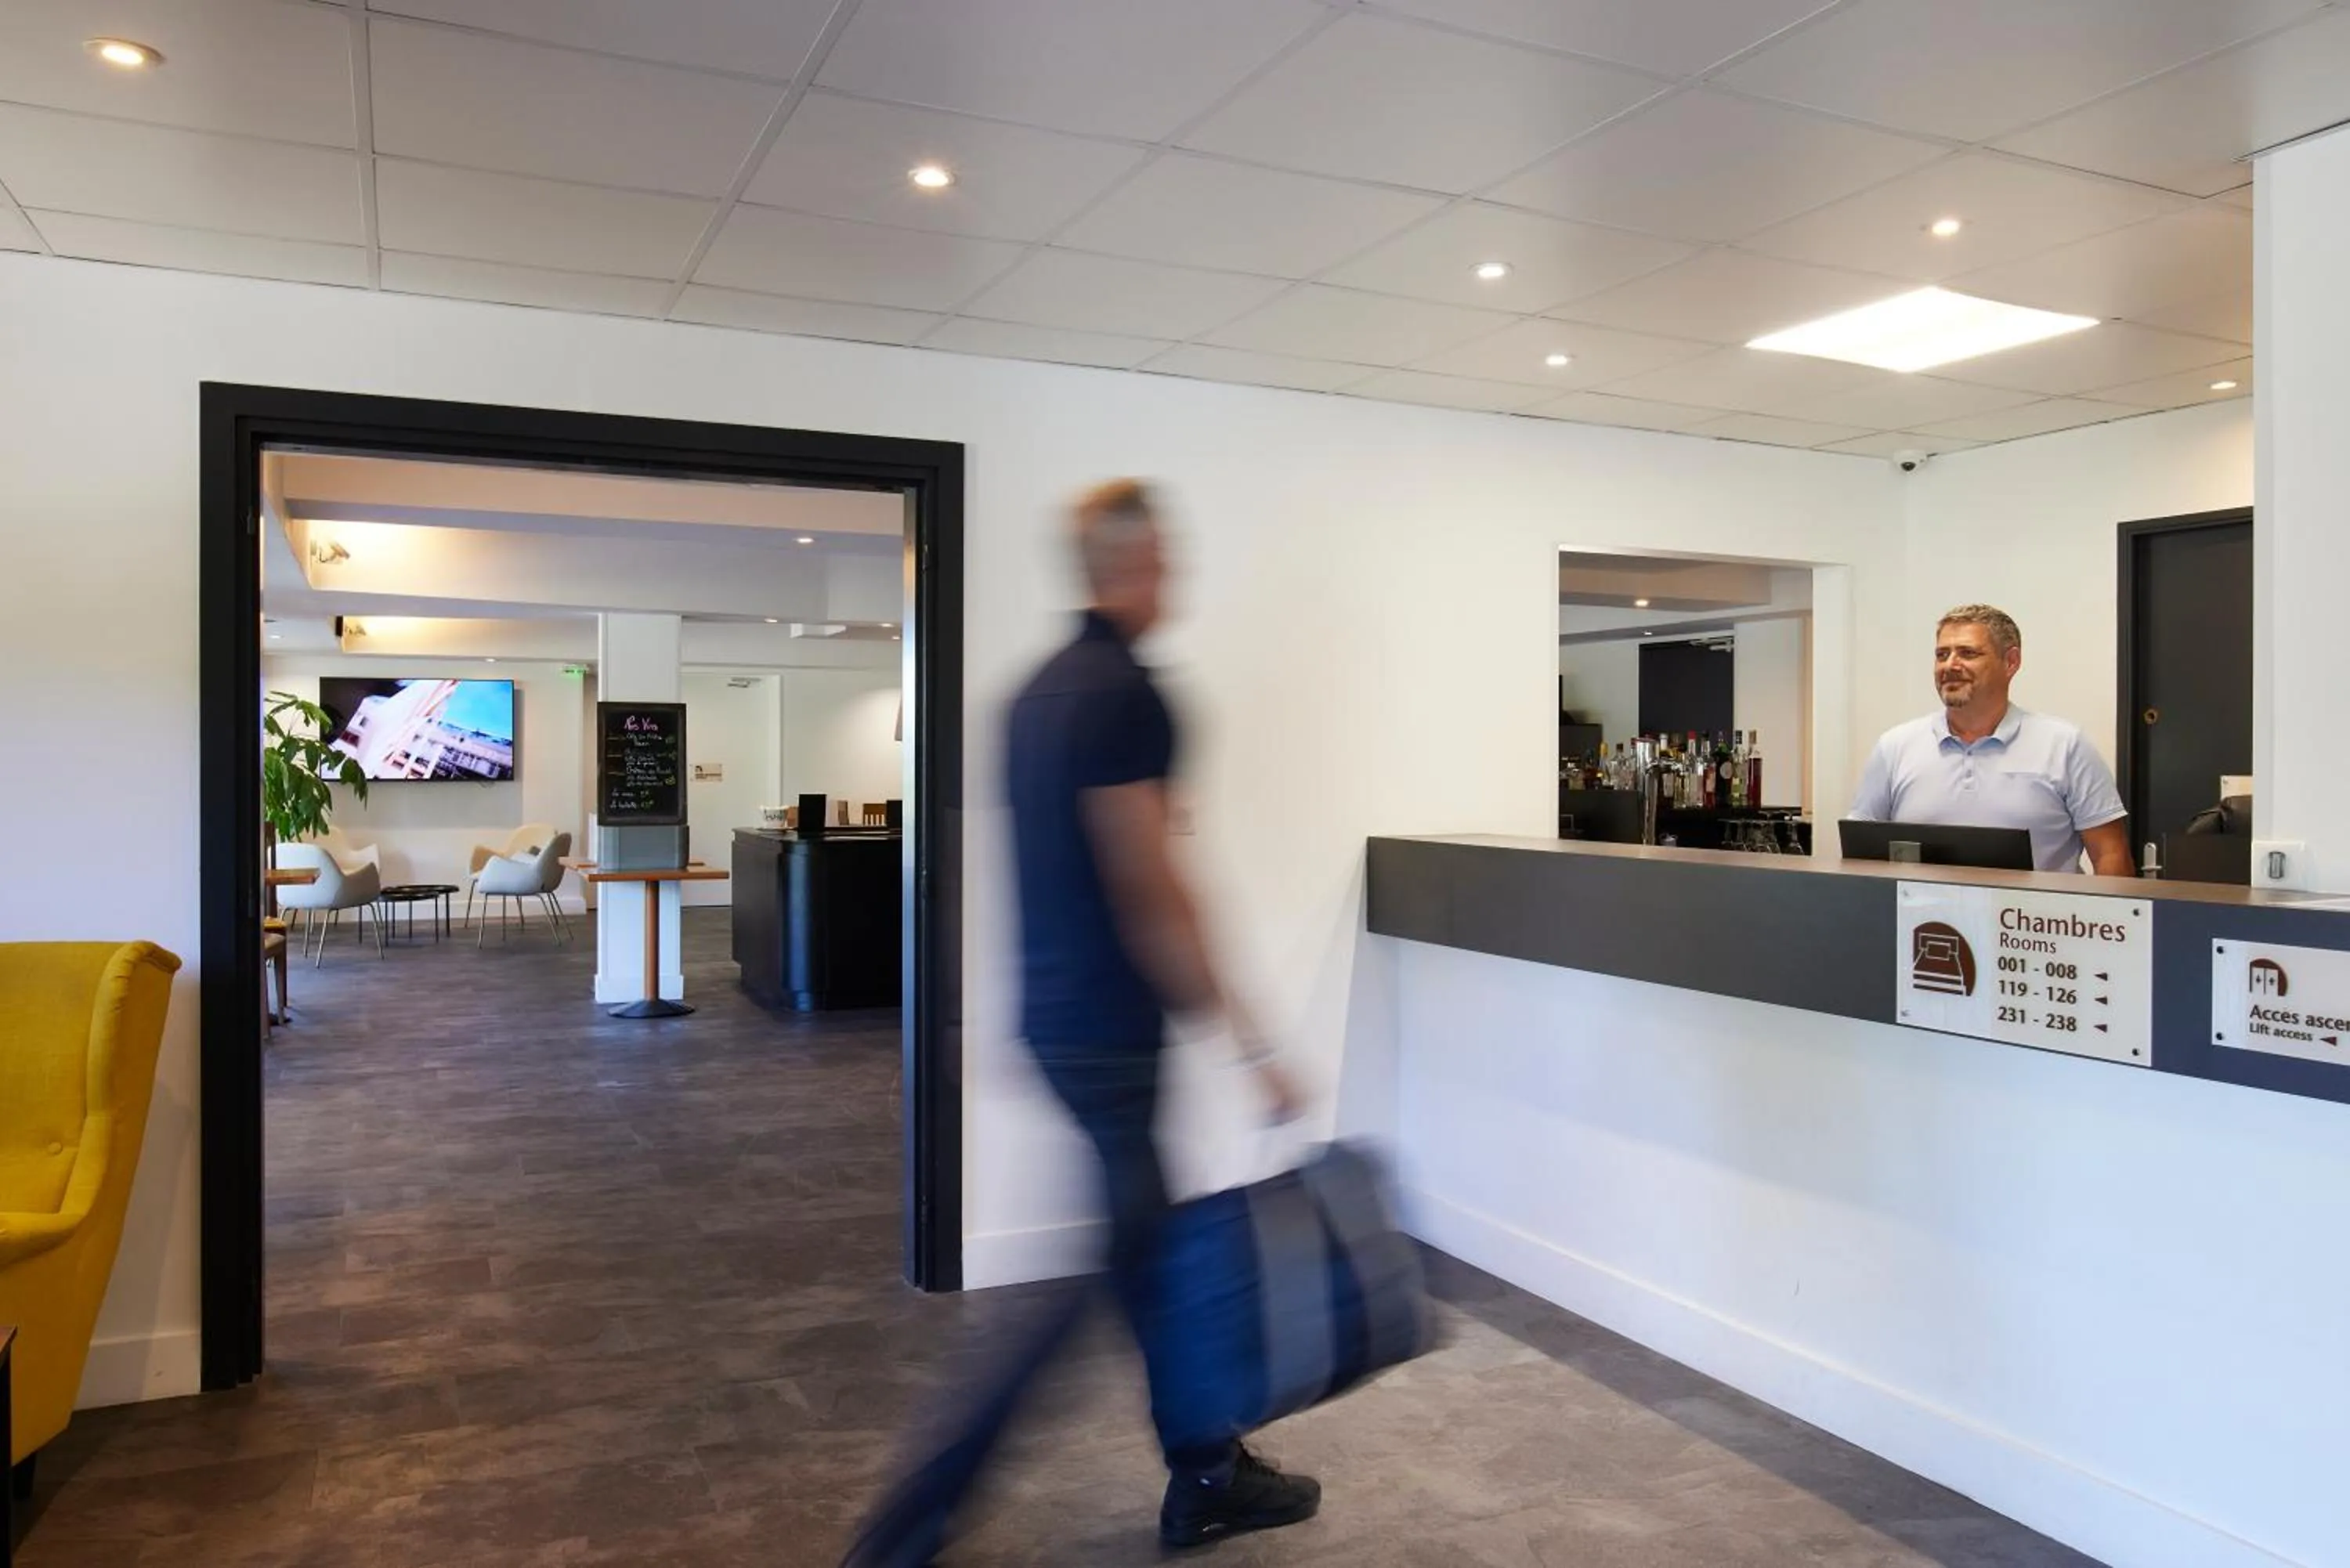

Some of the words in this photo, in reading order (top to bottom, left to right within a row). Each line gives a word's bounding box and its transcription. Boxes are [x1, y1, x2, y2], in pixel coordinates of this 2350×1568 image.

[1999, 908, 2126, 942] Chambres
[1999, 931, 2057, 954] Rooms
[1997, 956, 2027, 974] 001
[2044, 961, 2077, 981] 008
[1998, 979, 2028, 997] 119
[2045, 986, 2077, 1005] 126
[1997, 1006, 2026, 1024] 231
[2045, 1013, 2077, 1032] 238
[2249, 1022, 2271, 1035] Lift
[2272, 1028, 2313, 1042] access
